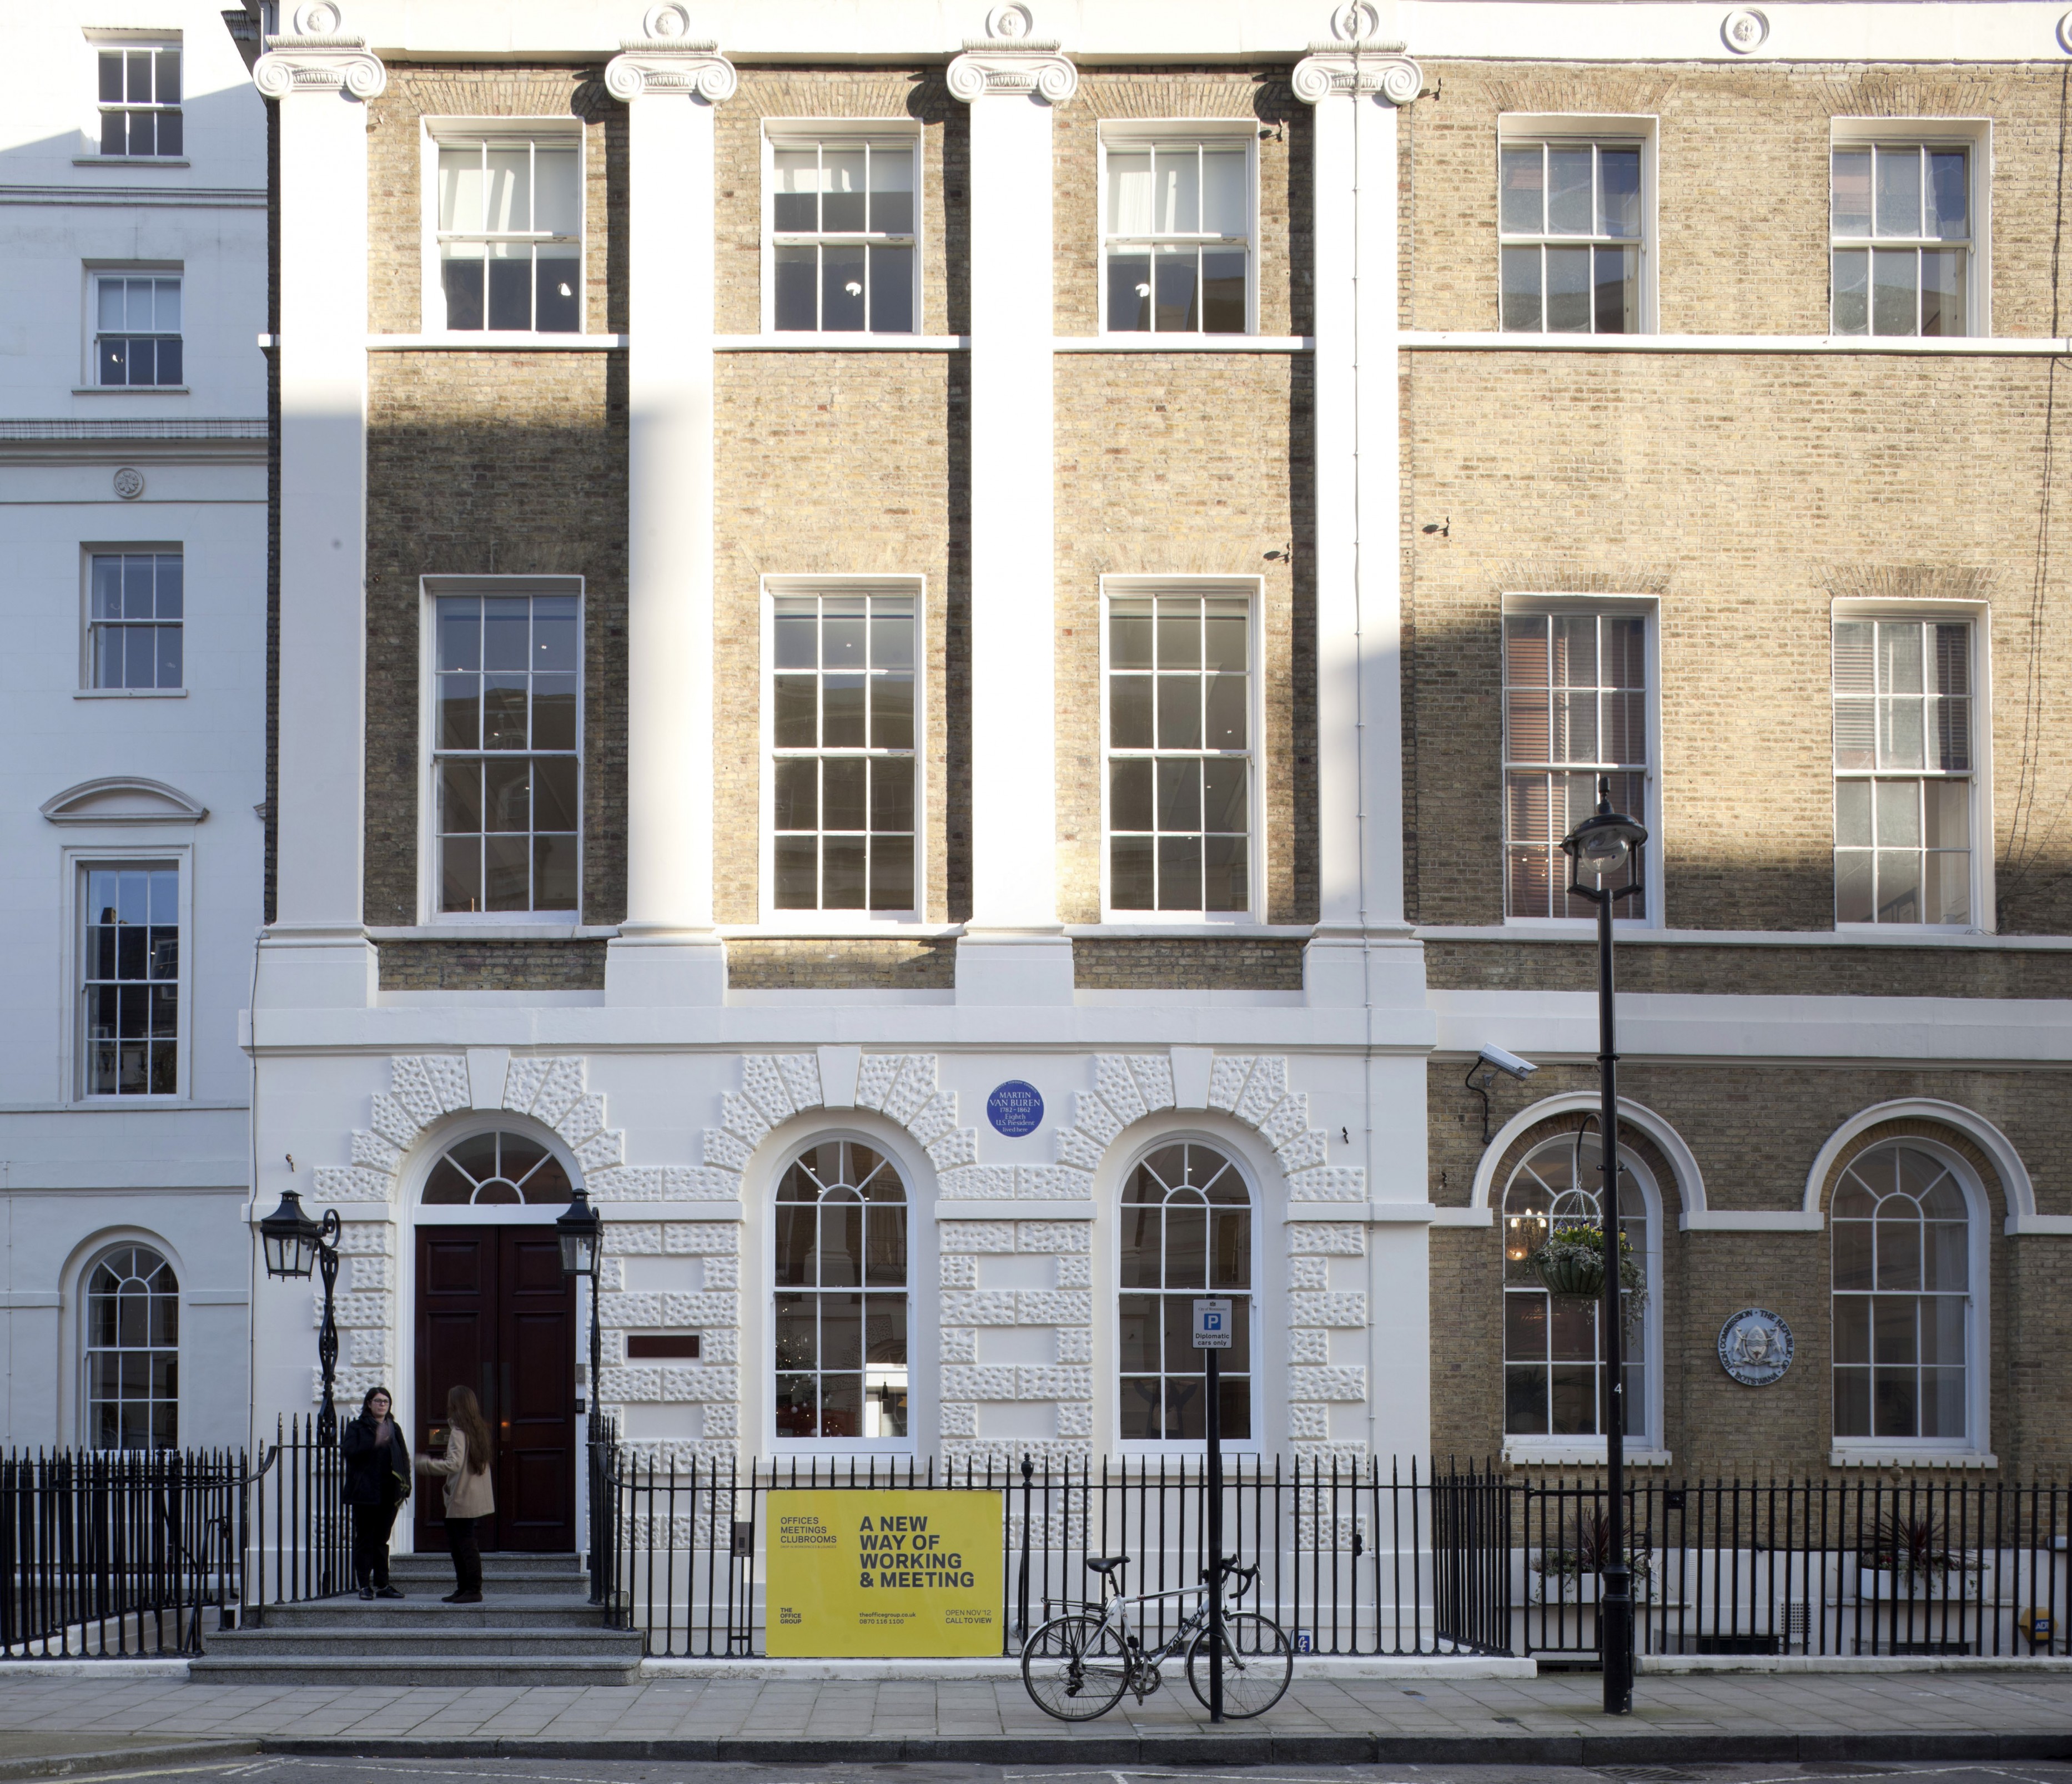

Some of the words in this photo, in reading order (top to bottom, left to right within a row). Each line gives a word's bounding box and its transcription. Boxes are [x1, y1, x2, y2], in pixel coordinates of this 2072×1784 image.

[1005, 1113, 1026, 1121] Eighth
[1208, 1315, 1219, 1329] P
[1759, 1309, 1777, 1322] THE
[1719, 1310, 1753, 1349] COMMISSION
[1776, 1318, 1794, 1359] REPUBLIC
[1720, 1350, 1732, 1370] HIGH
[1781, 1359, 1790, 1372] OF
[1734, 1371, 1780, 1385] BOTSWANA
[1614, 1383, 1622, 1394] 4
[859, 1516, 874, 1532] A
[880, 1516, 928, 1532] NEW
[859, 1535, 907, 1550] WAY
[912, 1534, 940, 1550] OF
[859, 1553, 962, 1569] WORKING
[859, 1571, 874, 1588] &
[881, 1571, 974, 1588] MEETING
